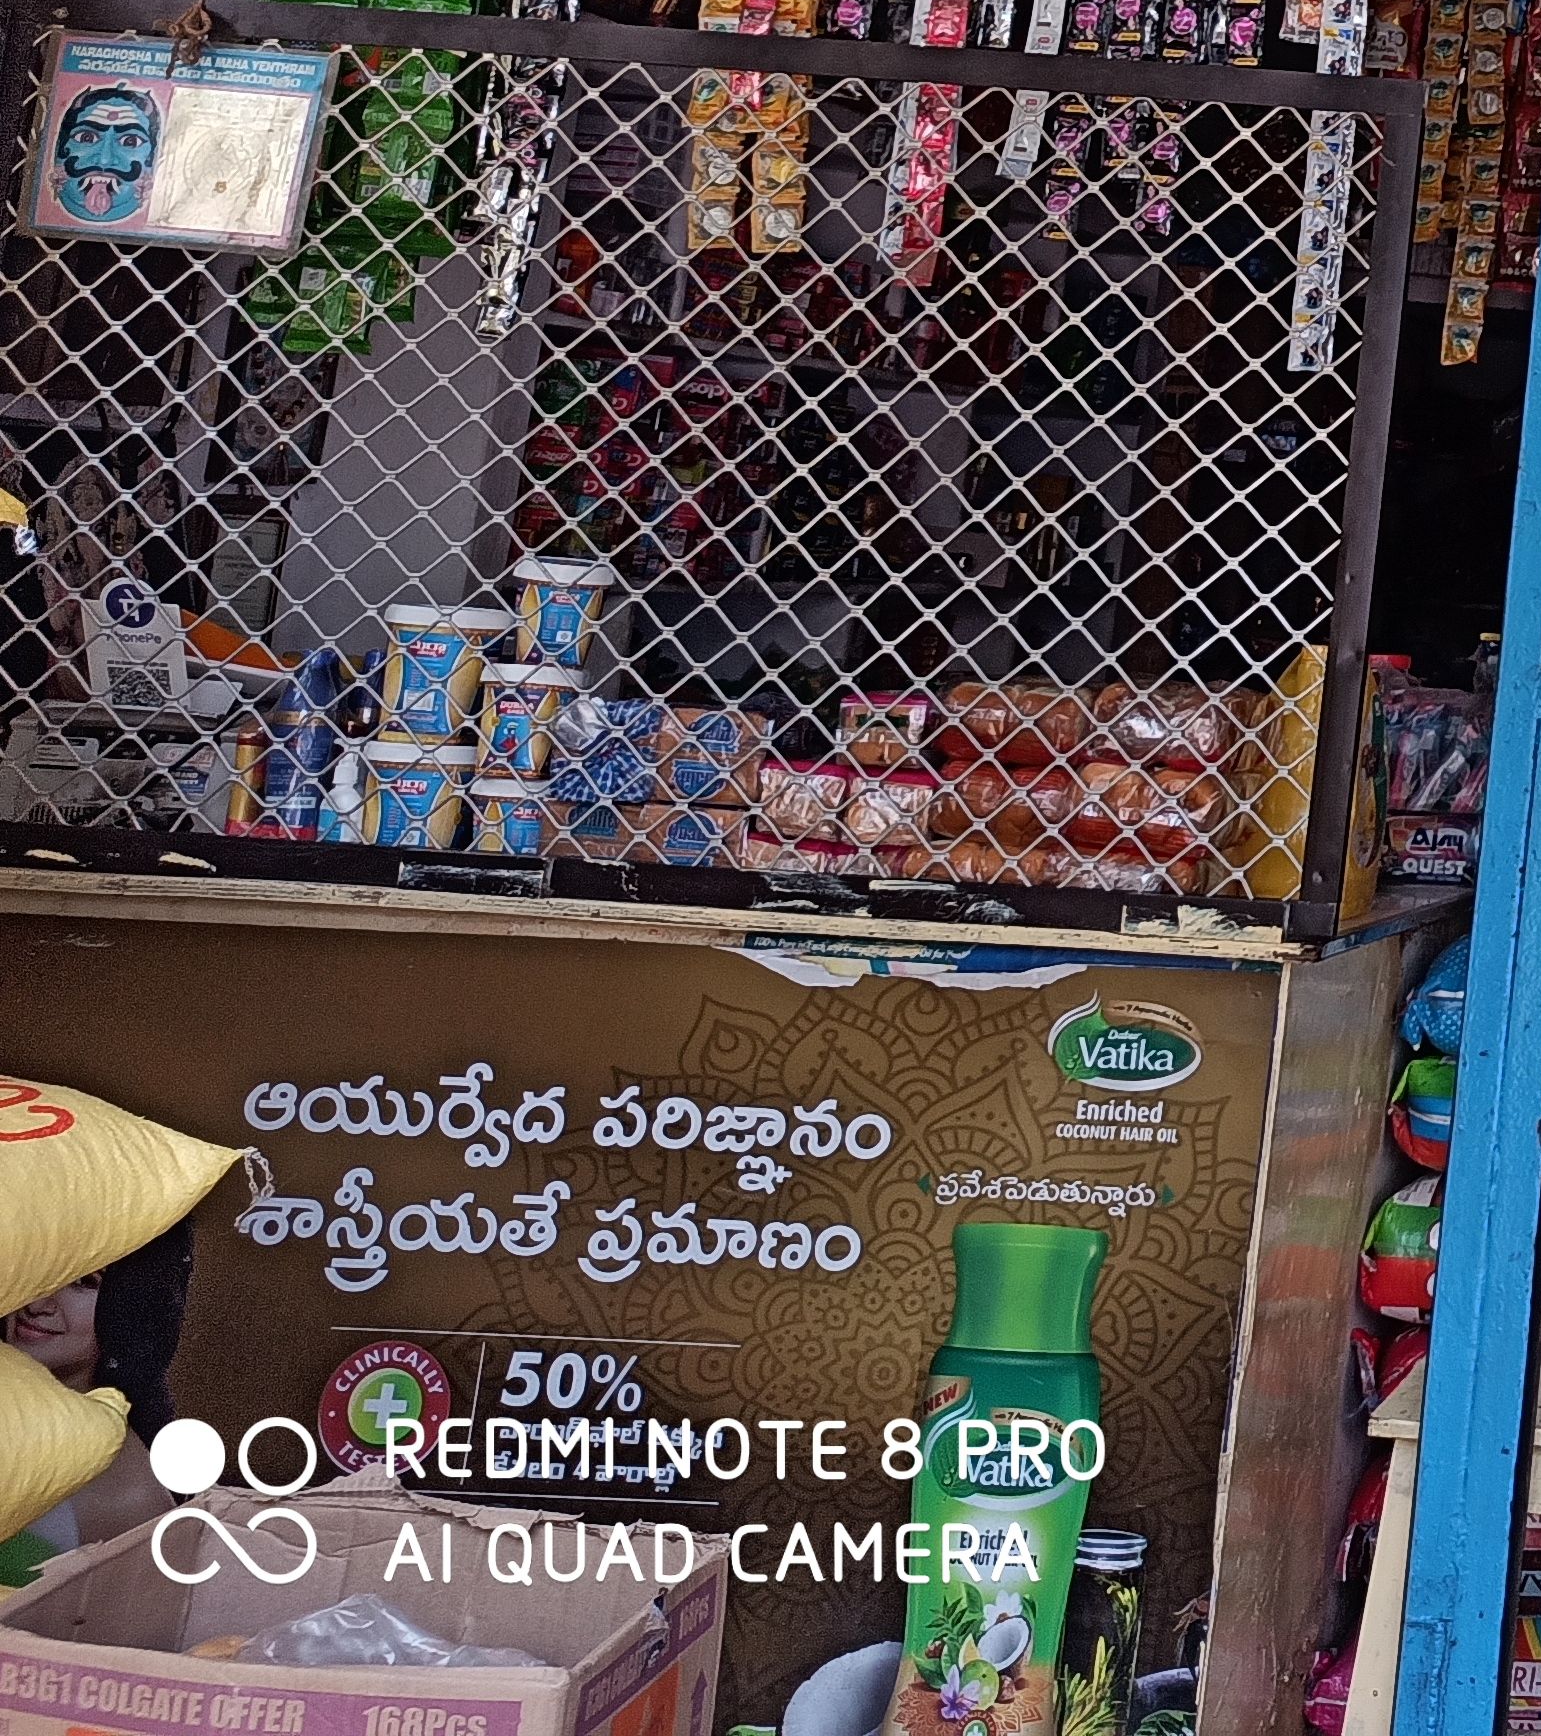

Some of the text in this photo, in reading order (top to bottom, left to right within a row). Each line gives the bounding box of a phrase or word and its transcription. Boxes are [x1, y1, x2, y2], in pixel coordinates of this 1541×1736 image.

[1402, 857, 1467, 875] QUEST
[1078, 1037, 1175, 1072] Vatika
[243, 1061, 893, 1192] ఆయుర్వేద పరిజ్ఞానం
[1075, 1099, 1164, 1124] Enriched
[1055, 1123, 1179, 1144] COCONUT HAIR OIL
[579, 1198, 863, 1283] ప్రమాణం
[334, 1346, 445, 1395] CLINICALLY
[499, 1350, 642, 1413] 50%
[922, 1382, 960, 1414] NEW
[78, 1675, 205, 1727] COLGATE
[210, 1691, 306, 1736] OFFER
